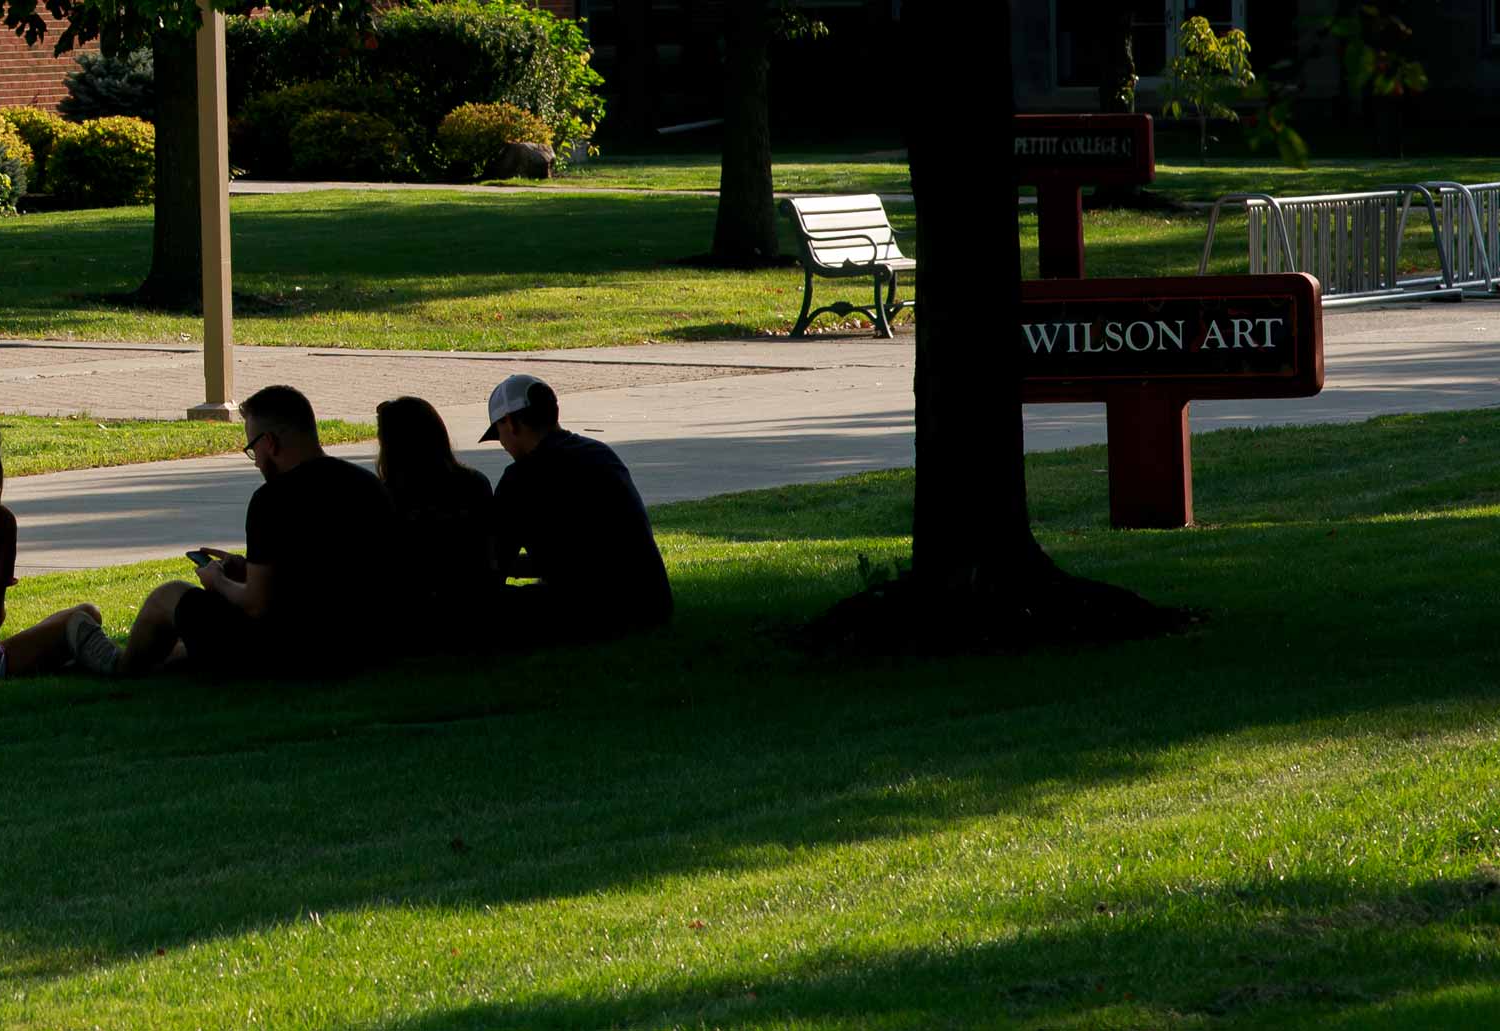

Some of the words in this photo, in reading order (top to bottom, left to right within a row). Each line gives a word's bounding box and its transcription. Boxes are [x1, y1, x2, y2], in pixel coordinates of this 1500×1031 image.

[1013, 136, 1060, 155] PETTIT
[1061, 136, 1118, 155] COLLEGE
[1021, 319, 1186, 354] WILSON
[1200, 317, 1284, 350] ART
